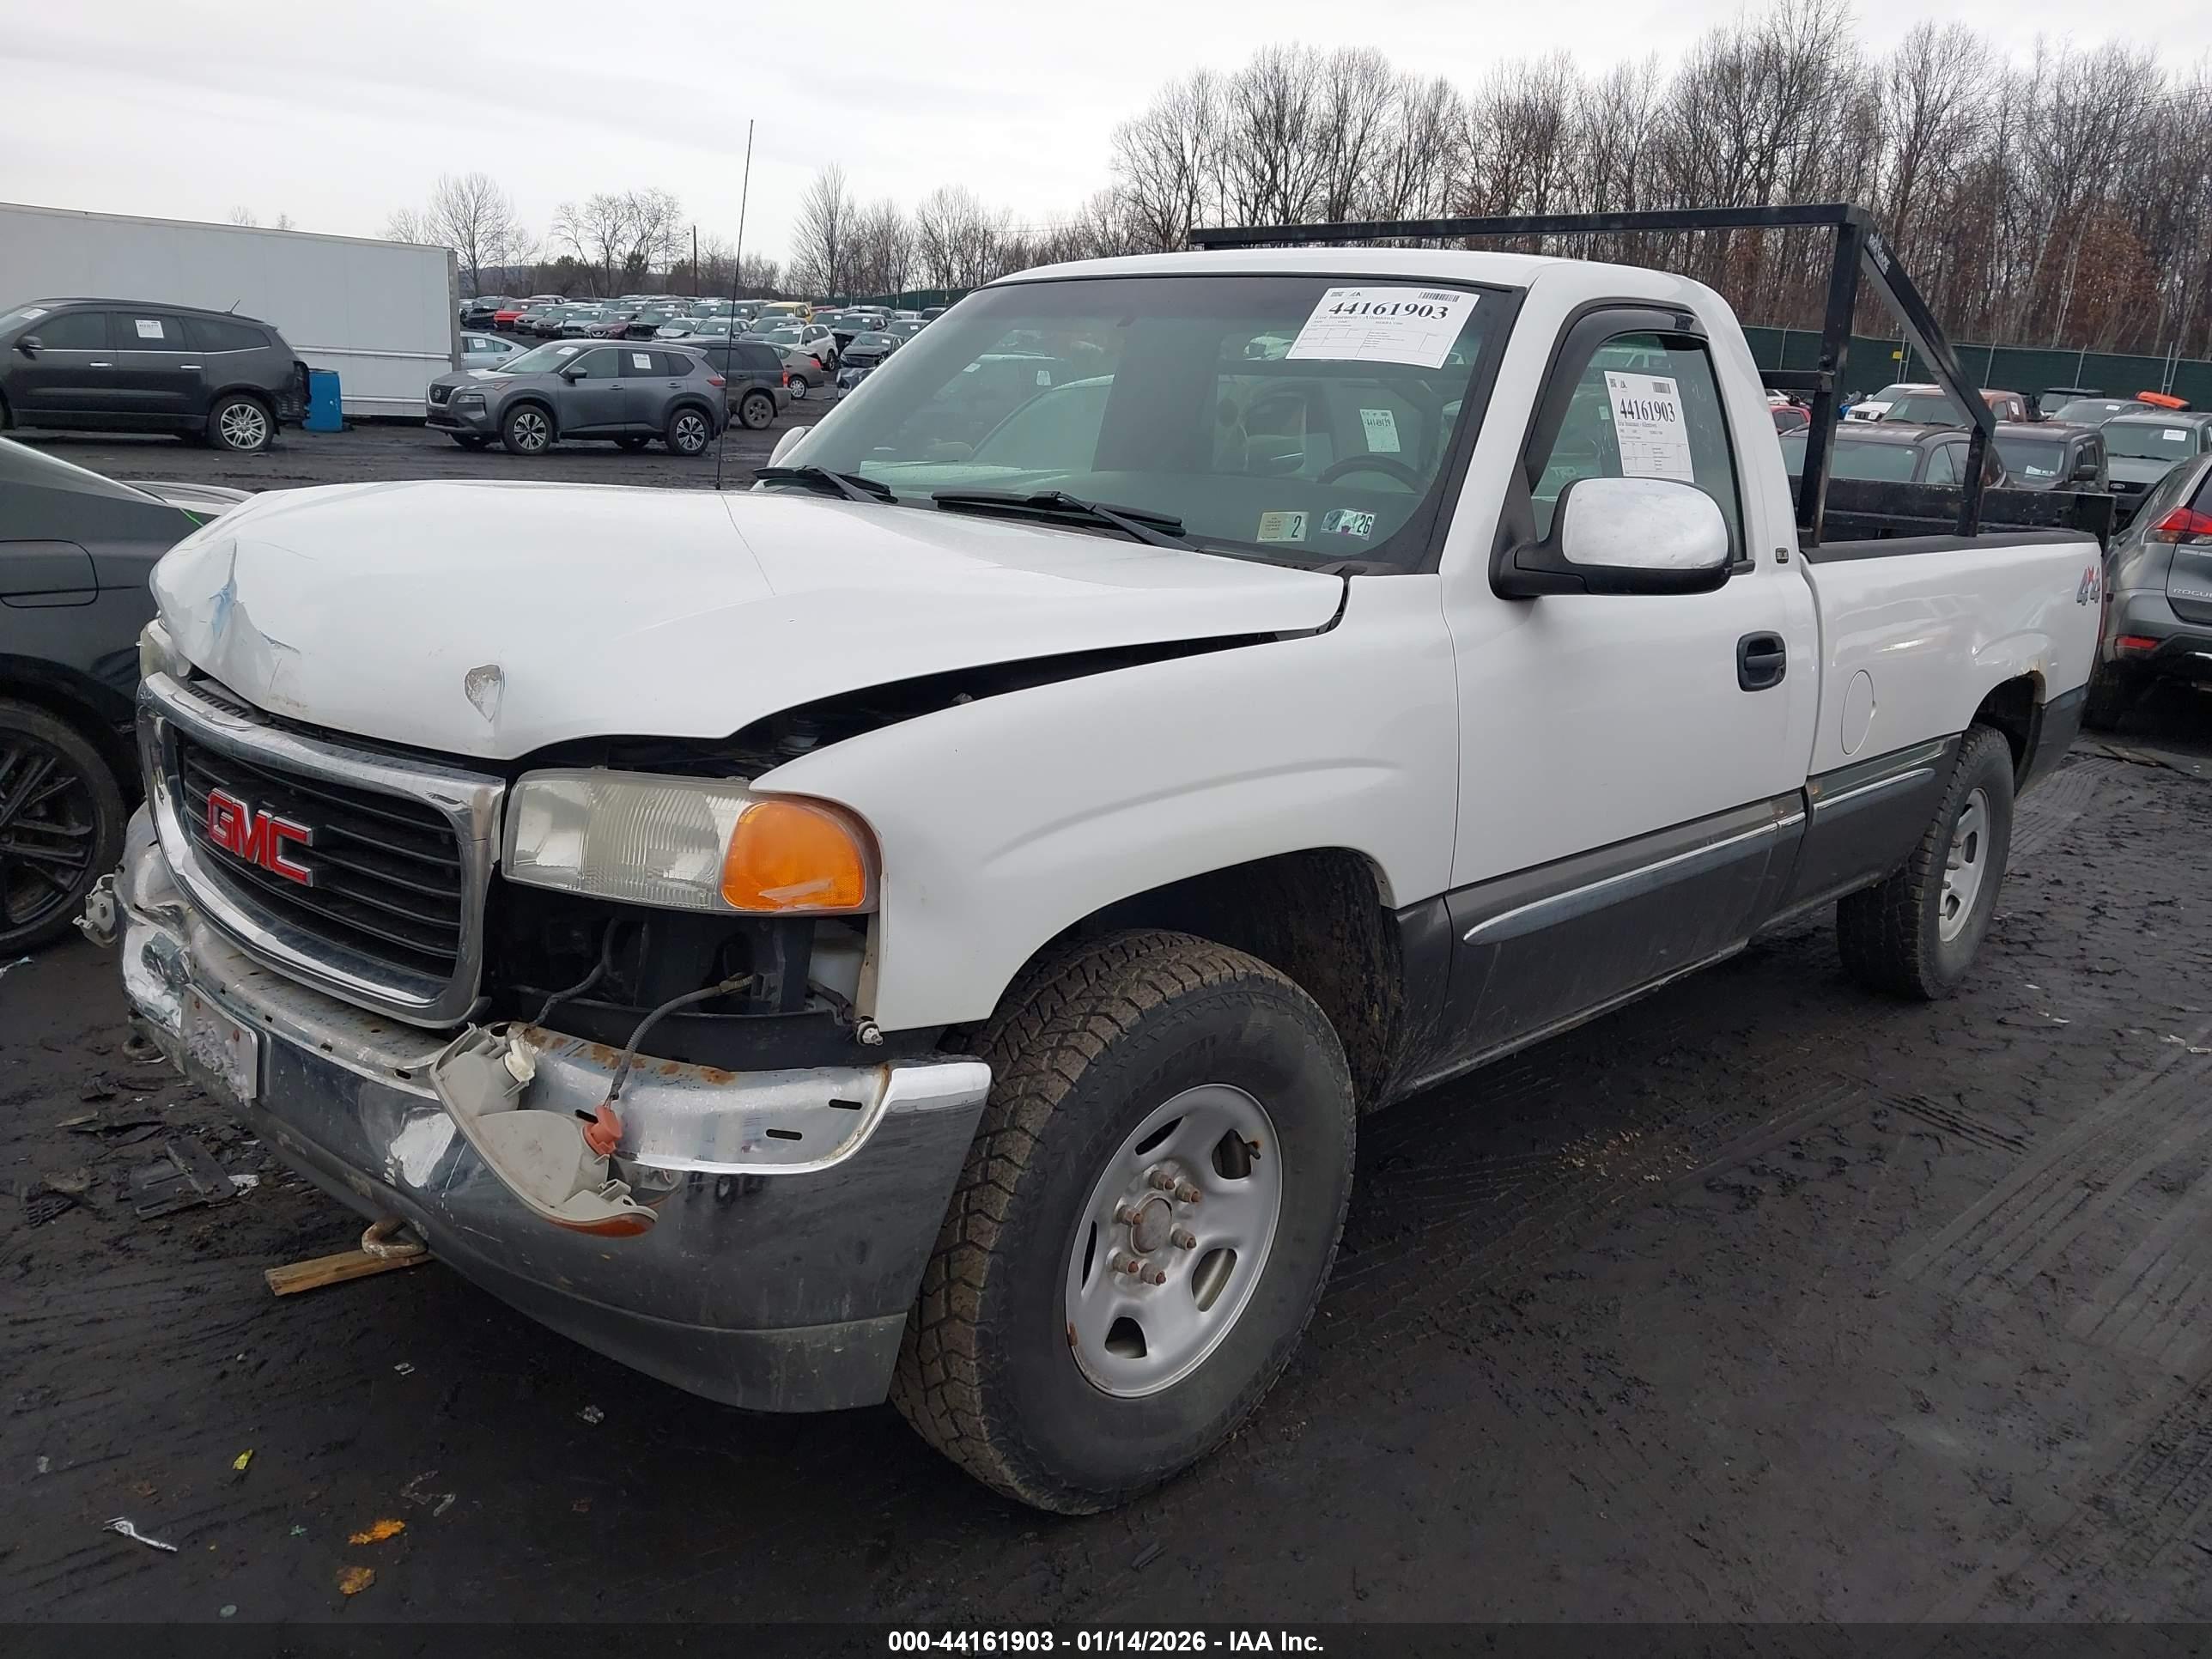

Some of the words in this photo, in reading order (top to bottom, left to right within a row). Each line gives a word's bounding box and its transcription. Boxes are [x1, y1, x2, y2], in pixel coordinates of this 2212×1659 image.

[1328, 302, 1449, 319] 44161903
[1620, 398, 1675, 422] 44161903
[1291, 515, 1303, 538] 2
[207, 787, 313, 887] GMC
